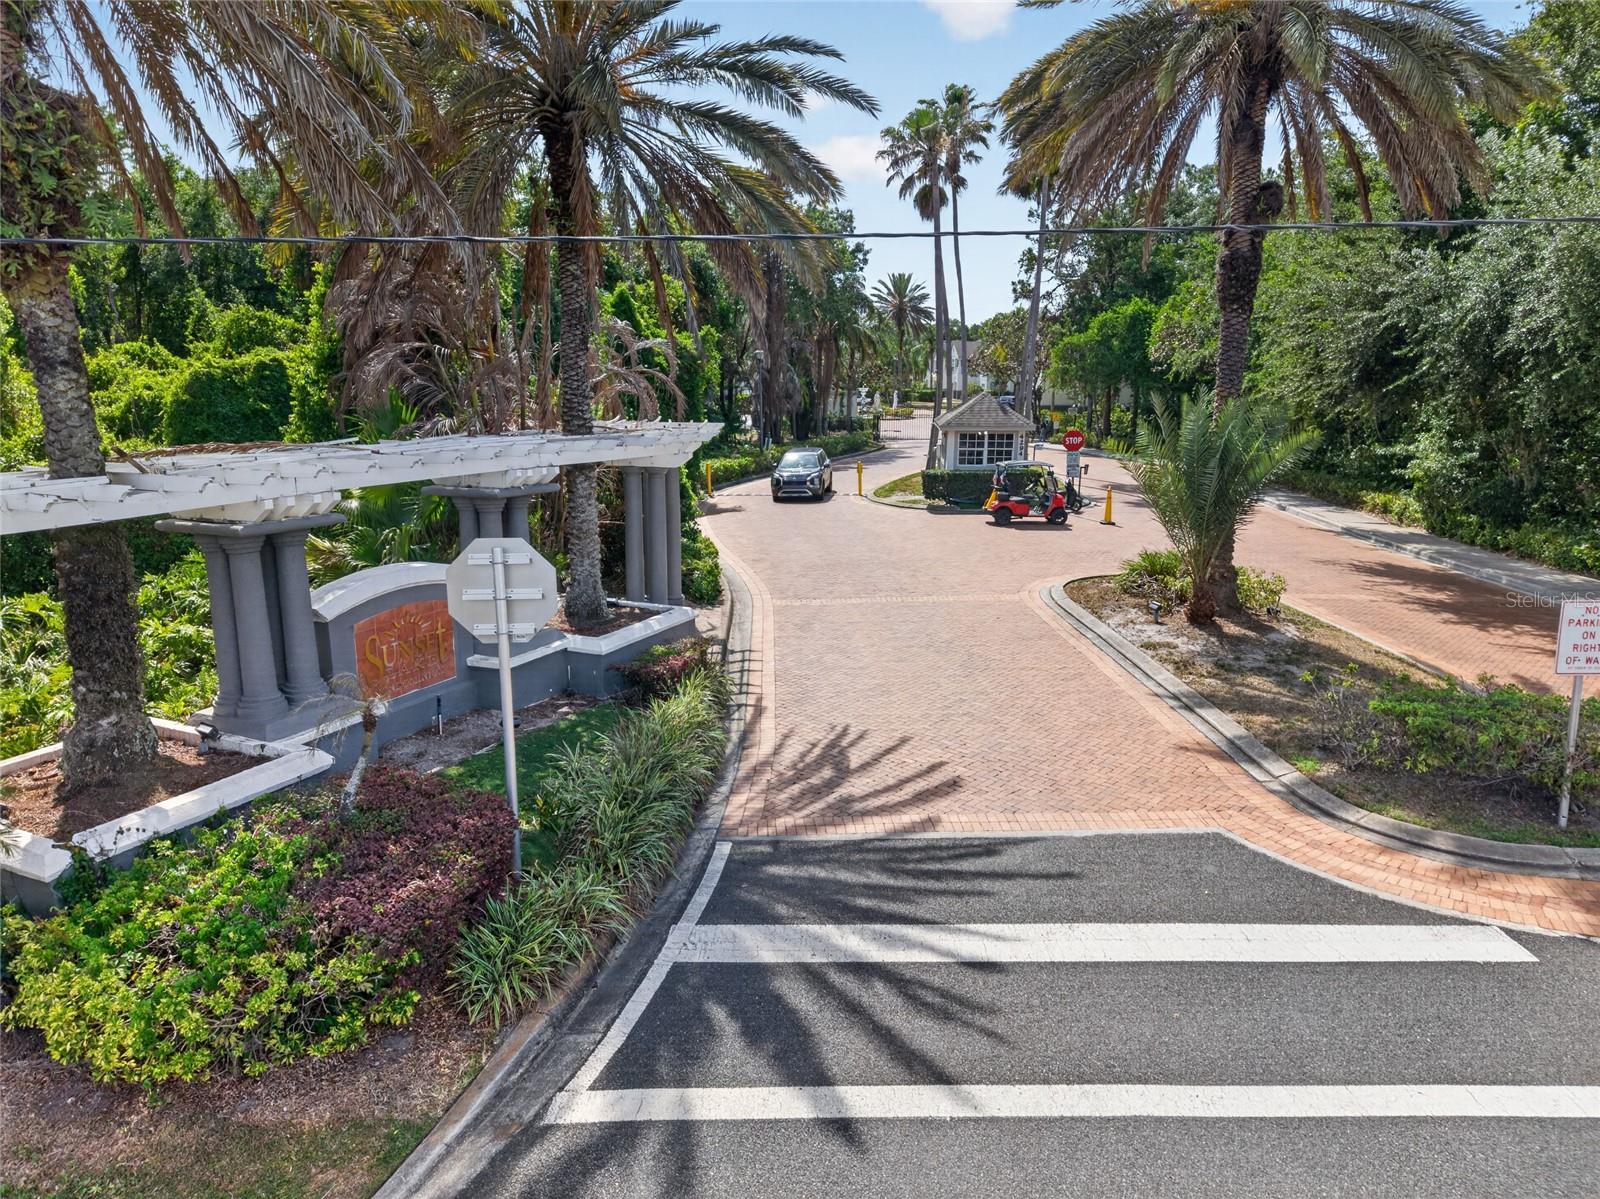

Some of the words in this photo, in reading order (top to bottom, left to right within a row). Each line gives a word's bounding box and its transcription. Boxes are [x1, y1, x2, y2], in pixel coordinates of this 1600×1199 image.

[1568, 619, 1600, 627] PARKI
[1582, 631, 1596, 640] ON
[1565, 656, 1579, 665] OF
[1585, 656, 1600, 665] WA
